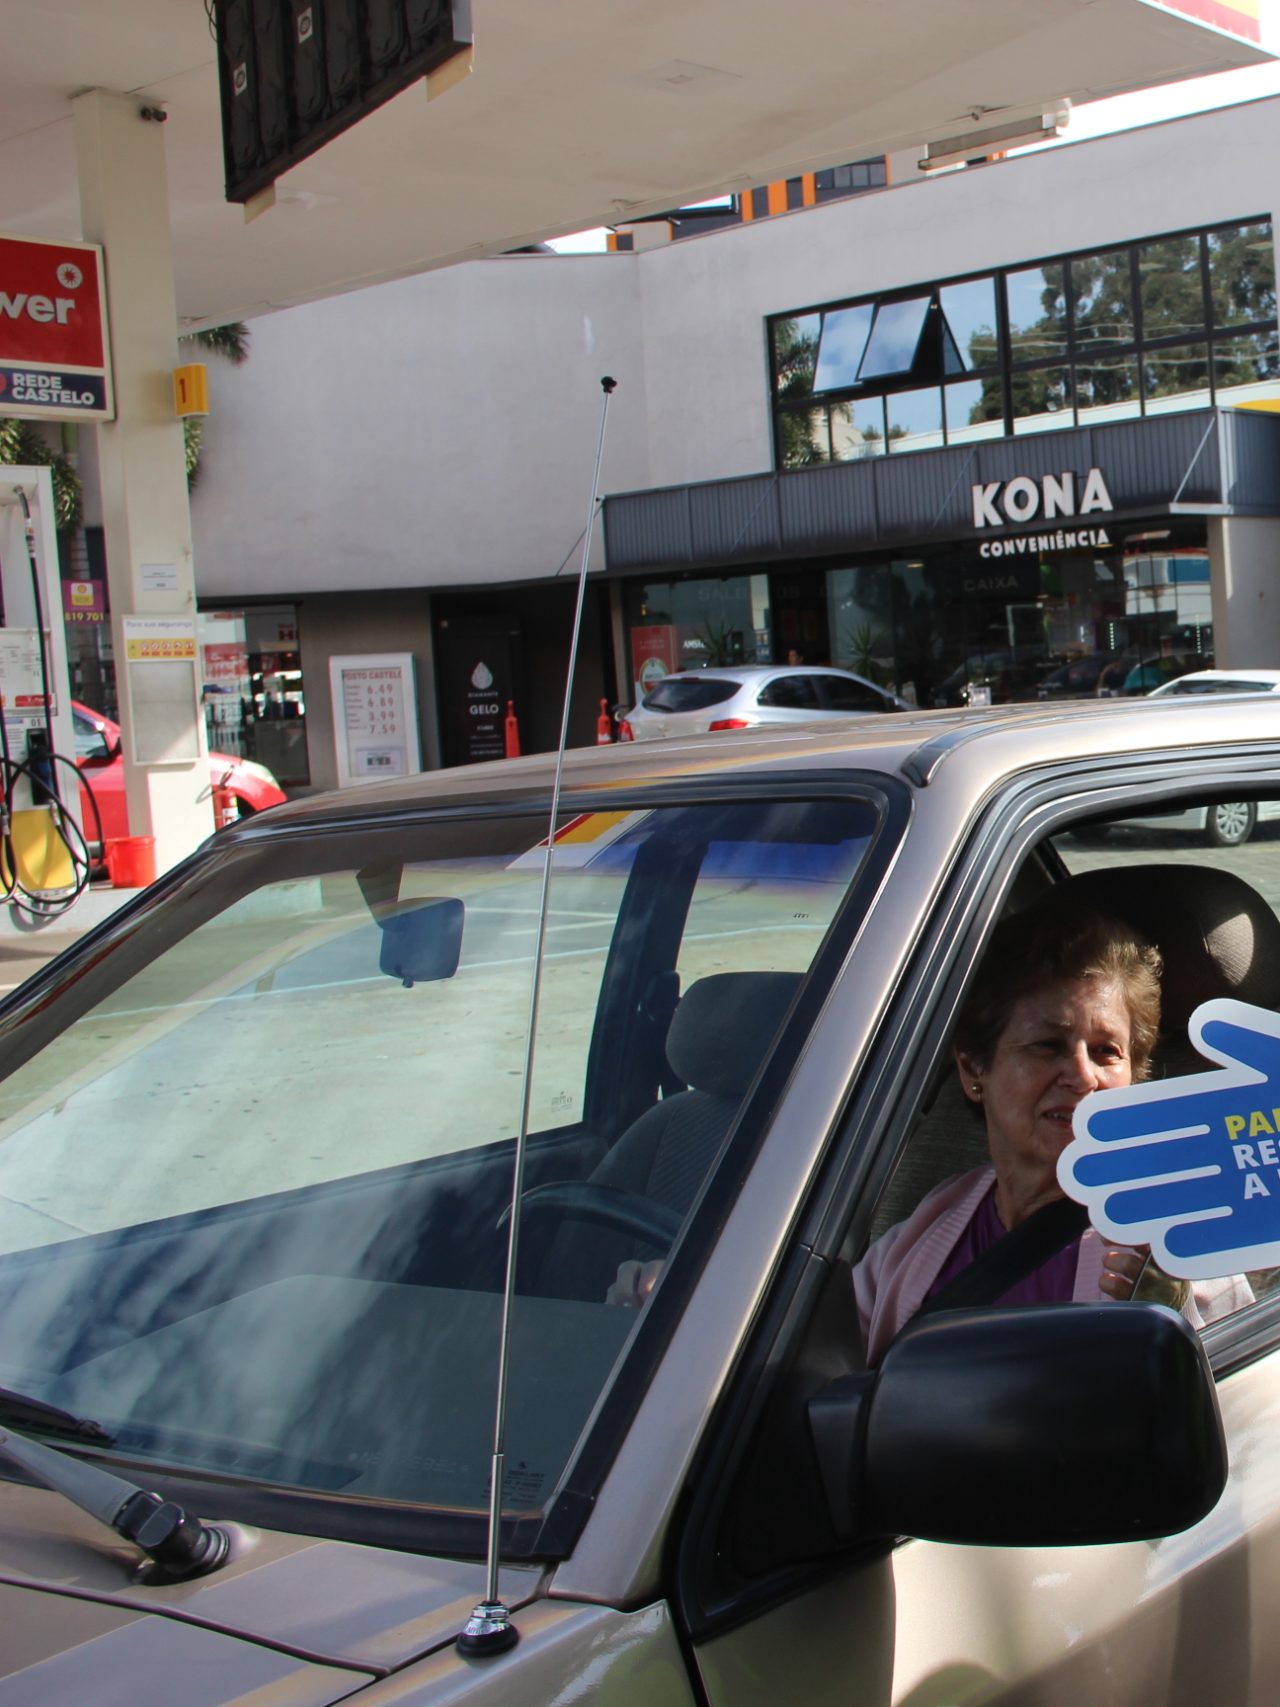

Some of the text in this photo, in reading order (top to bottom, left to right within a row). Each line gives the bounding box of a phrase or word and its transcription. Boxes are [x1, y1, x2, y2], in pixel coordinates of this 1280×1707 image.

[12, 373, 62, 390] REDE
[12, 387, 95, 406] CASTELO
[179, 378, 187, 404] 1
[972, 468, 1114, 528] KONA
[980, 528, 1110, 558] CONVENIÊNCIA
[964, 575, 1018, 592] CAIXA
[367, 683, 393, 695] 6.49
[469, 704, 499, 716] GELO
[369, 724, 396, 735] 7.59
[1244, 1173, 1271, 1200] A
